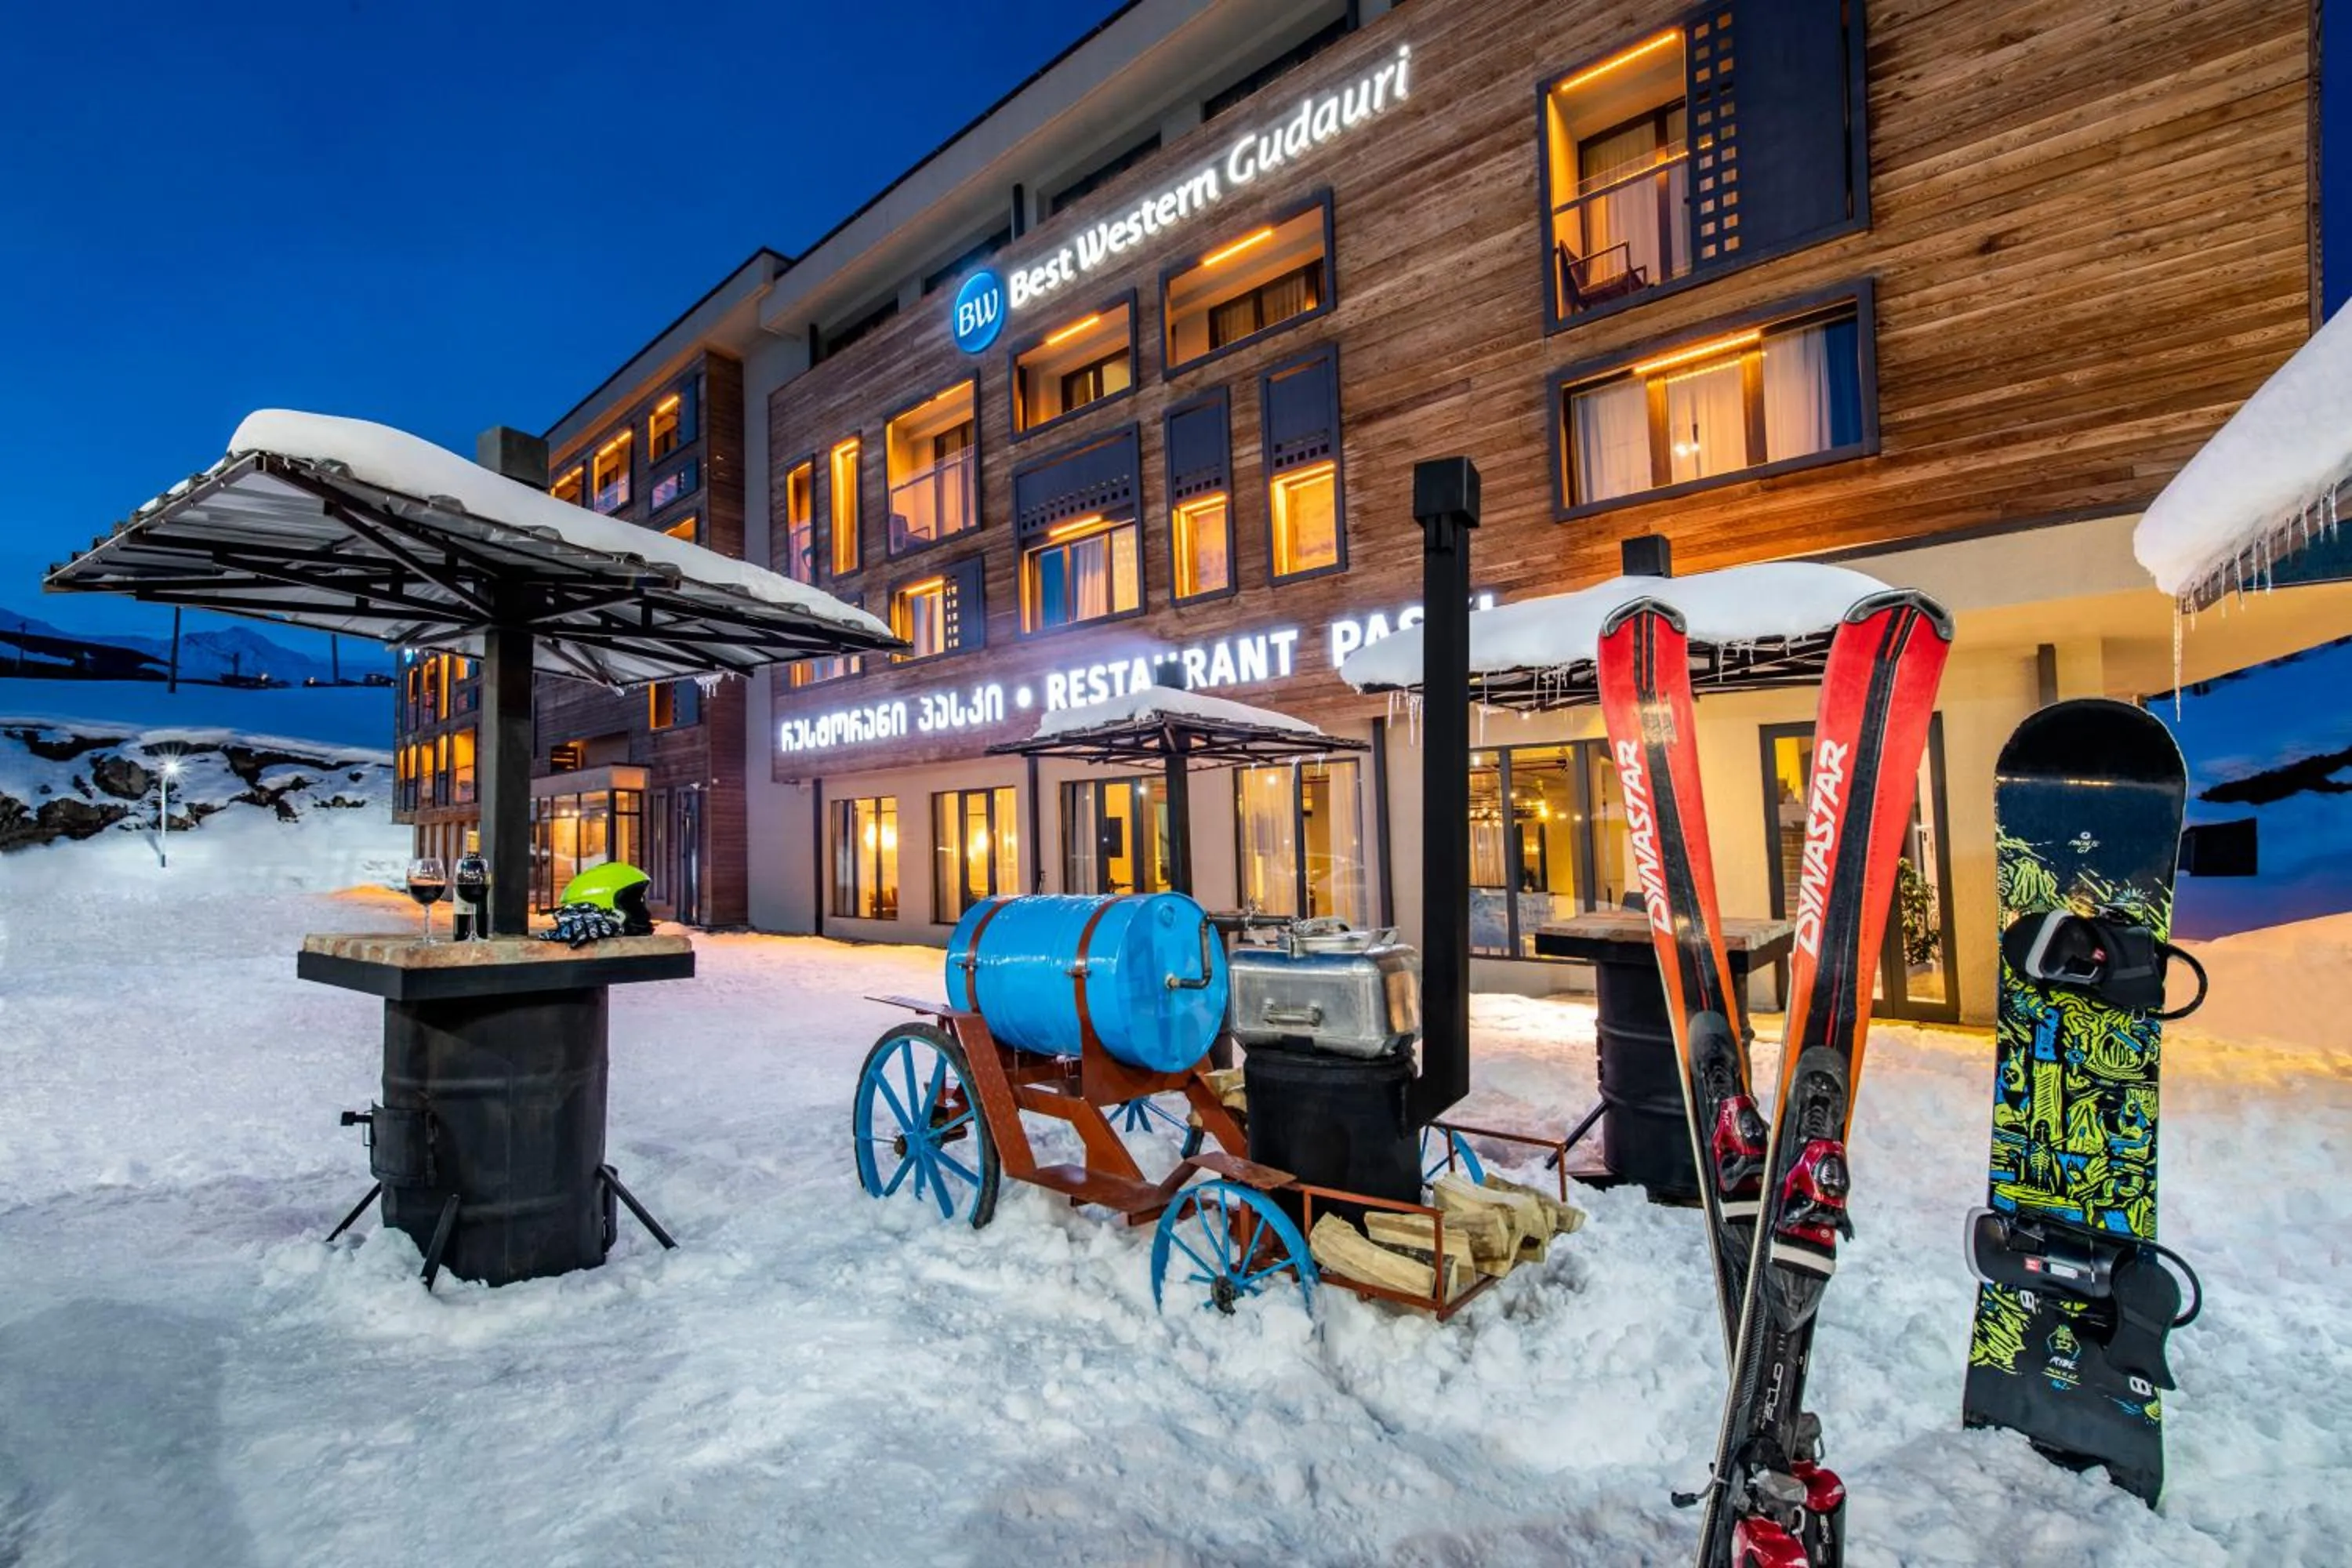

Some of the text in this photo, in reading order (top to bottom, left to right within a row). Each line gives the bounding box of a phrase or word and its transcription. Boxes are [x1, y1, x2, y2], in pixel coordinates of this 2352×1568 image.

[1009, 45, 1410, 309] Best Western Gudauri
[959, 288, 998, 337] BW
[1046, 630, 1298, 712] RESTARANT
[1616, 739, 1673, 935] DYNASTAR
[1793, 739, 1848, 959] DYNASTAR
